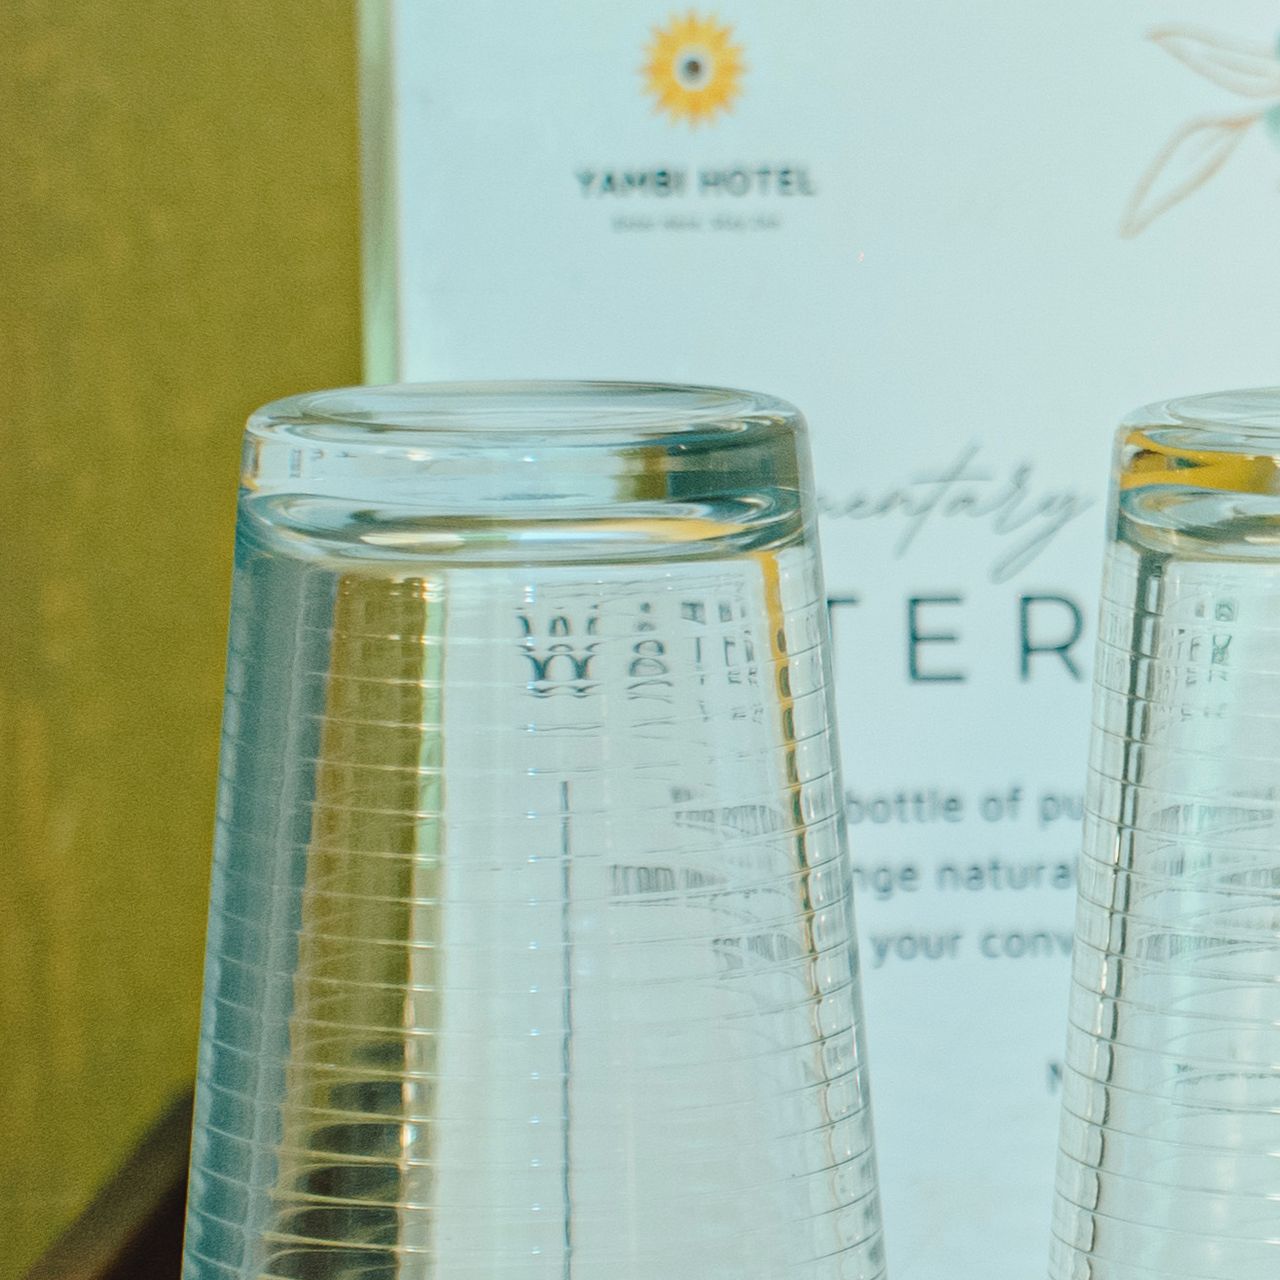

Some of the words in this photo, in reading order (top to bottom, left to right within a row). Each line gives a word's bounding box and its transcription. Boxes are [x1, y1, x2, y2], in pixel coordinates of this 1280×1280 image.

[576, 166, 686, 199] YAMBI
[697, 165, 816, 198] HOTEL
[817, 438, 1097, 583] entary
[980, 783, 1024, 823] of
[870, 931, 964, 969] your
